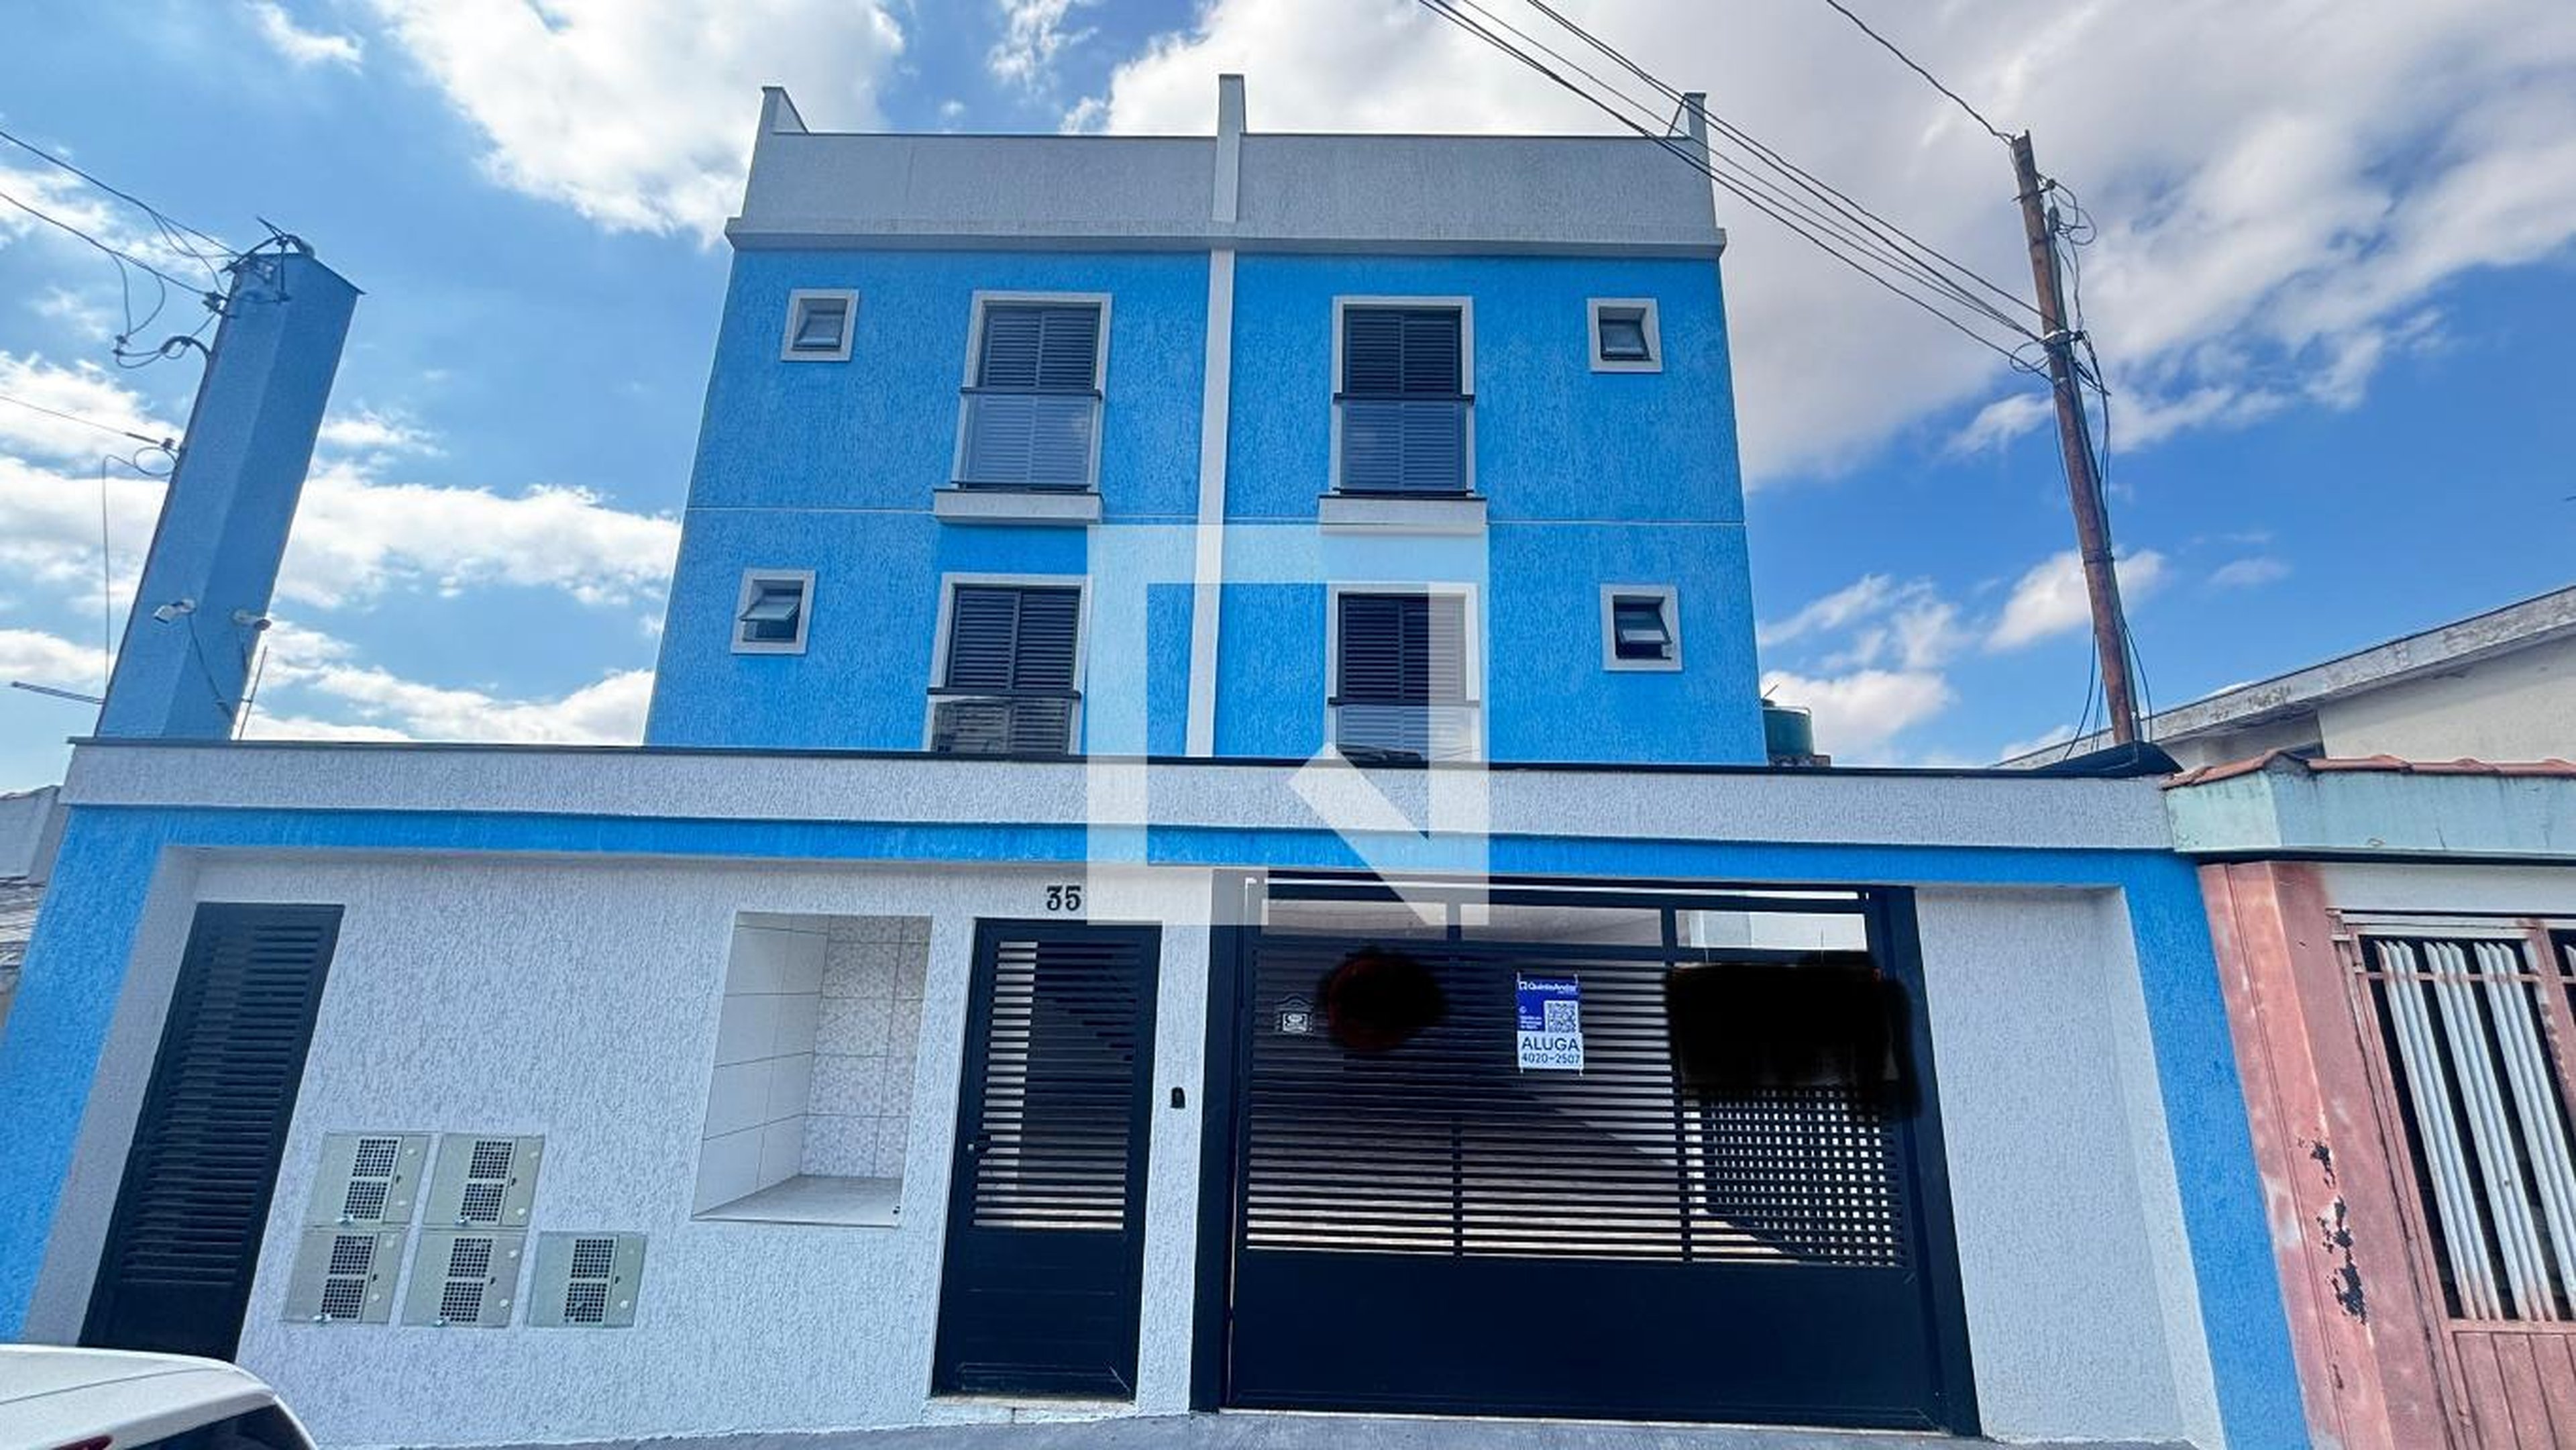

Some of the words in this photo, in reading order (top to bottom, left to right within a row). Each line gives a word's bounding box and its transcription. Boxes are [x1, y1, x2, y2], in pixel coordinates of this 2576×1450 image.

[1046, 885, 1081, 912] 35
[1521, 1037, 1580, 1052] ALUGA
[1521, 1052, 1580, 1064] 4020-2507
